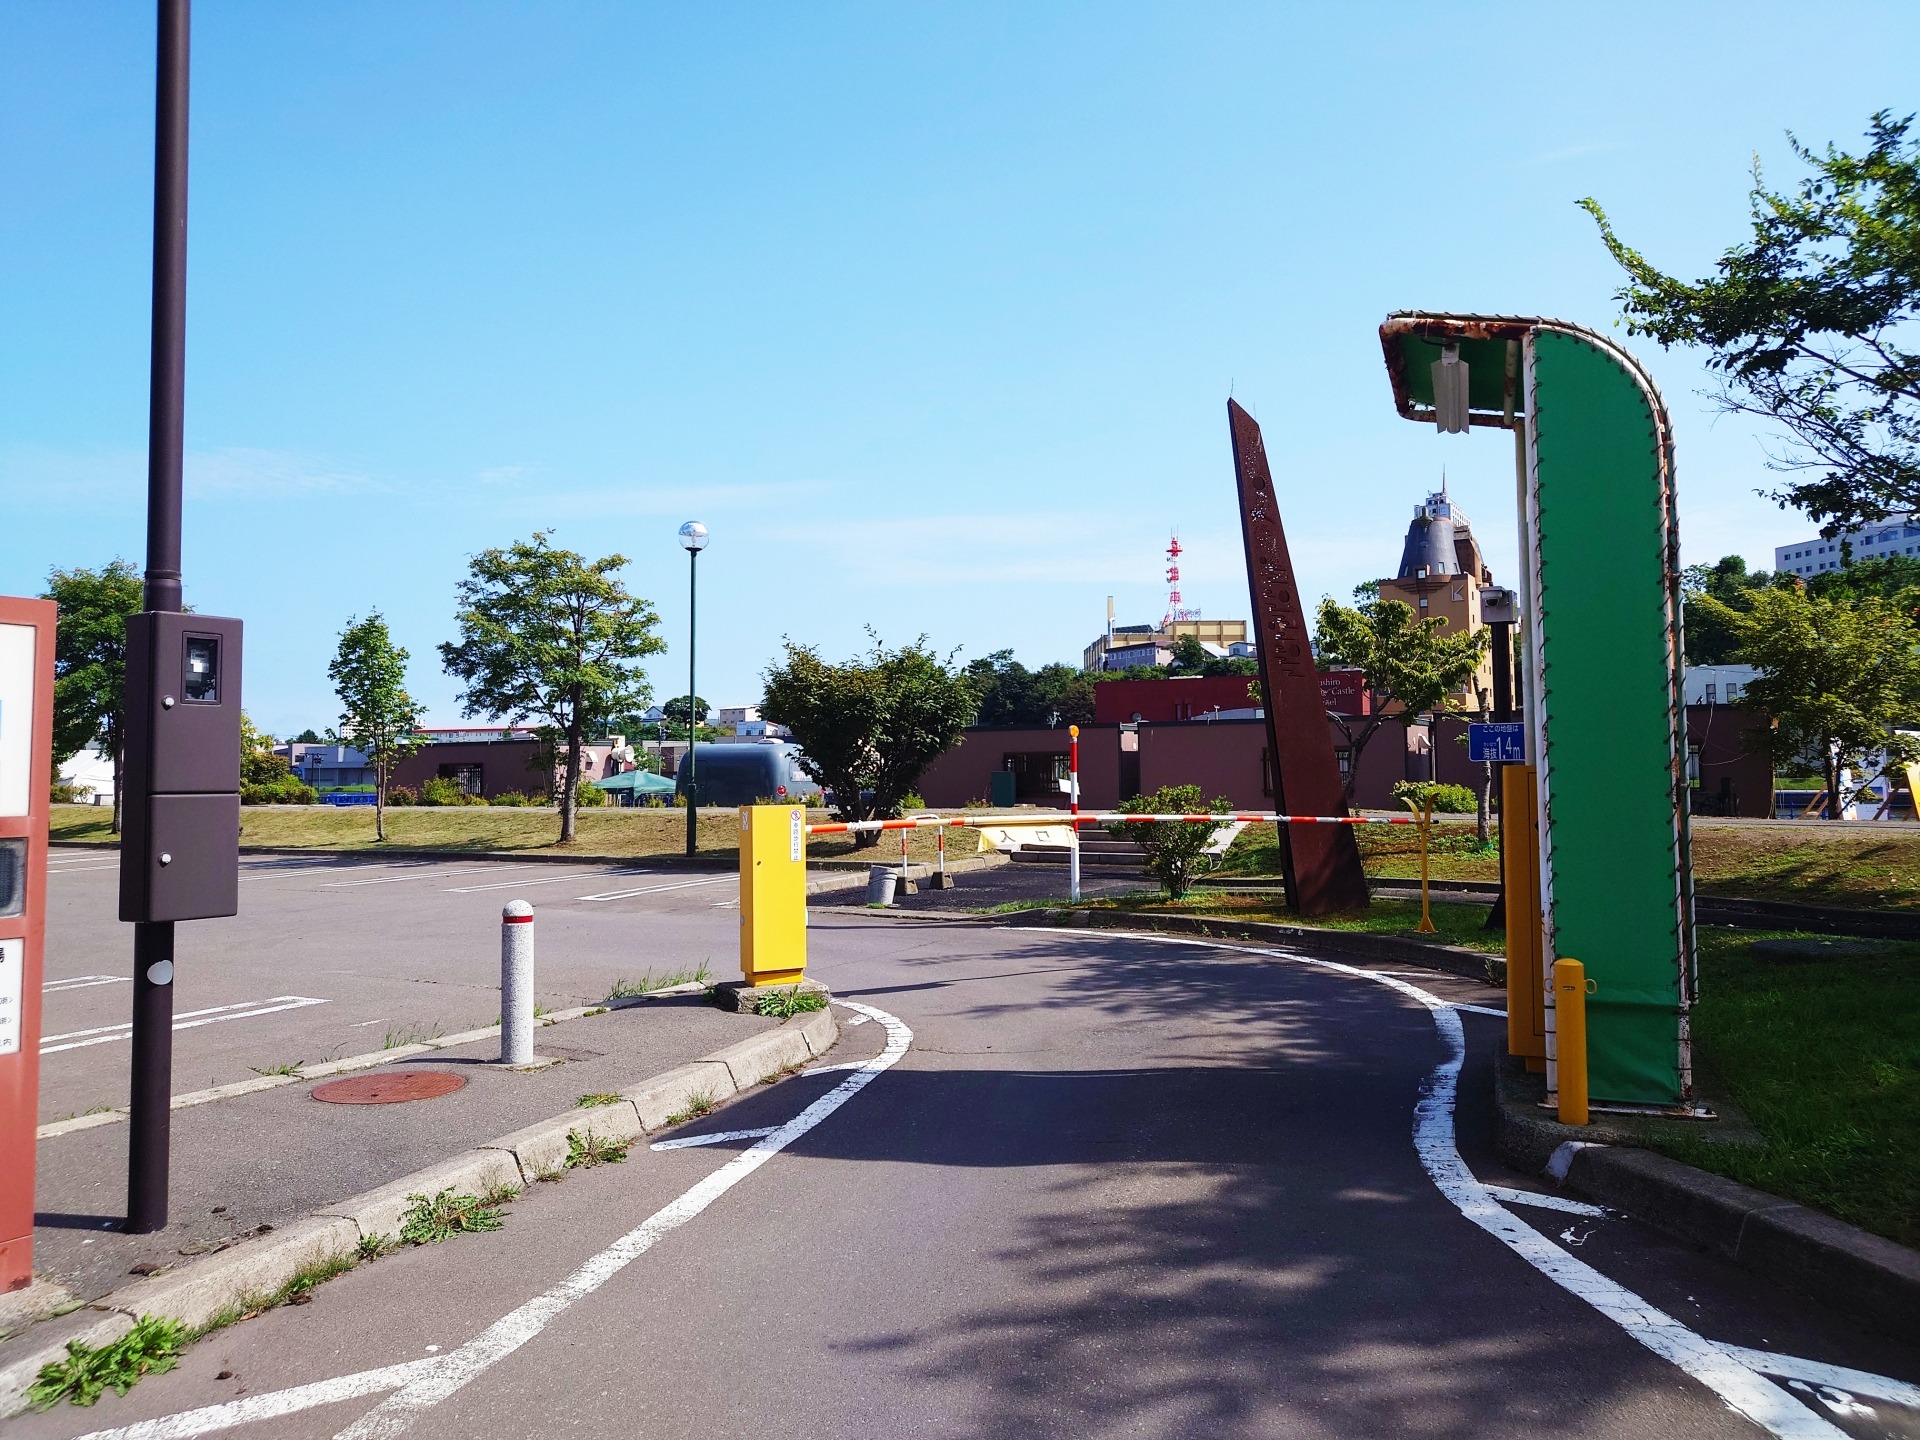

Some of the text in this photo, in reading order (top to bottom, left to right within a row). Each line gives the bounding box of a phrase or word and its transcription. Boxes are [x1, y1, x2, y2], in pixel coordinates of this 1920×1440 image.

[1331, 686, 1355, 696] Castle
[1483, 725, 1519, 733] ここの地盤は
[1000, 830, 1051, 843] 入口
